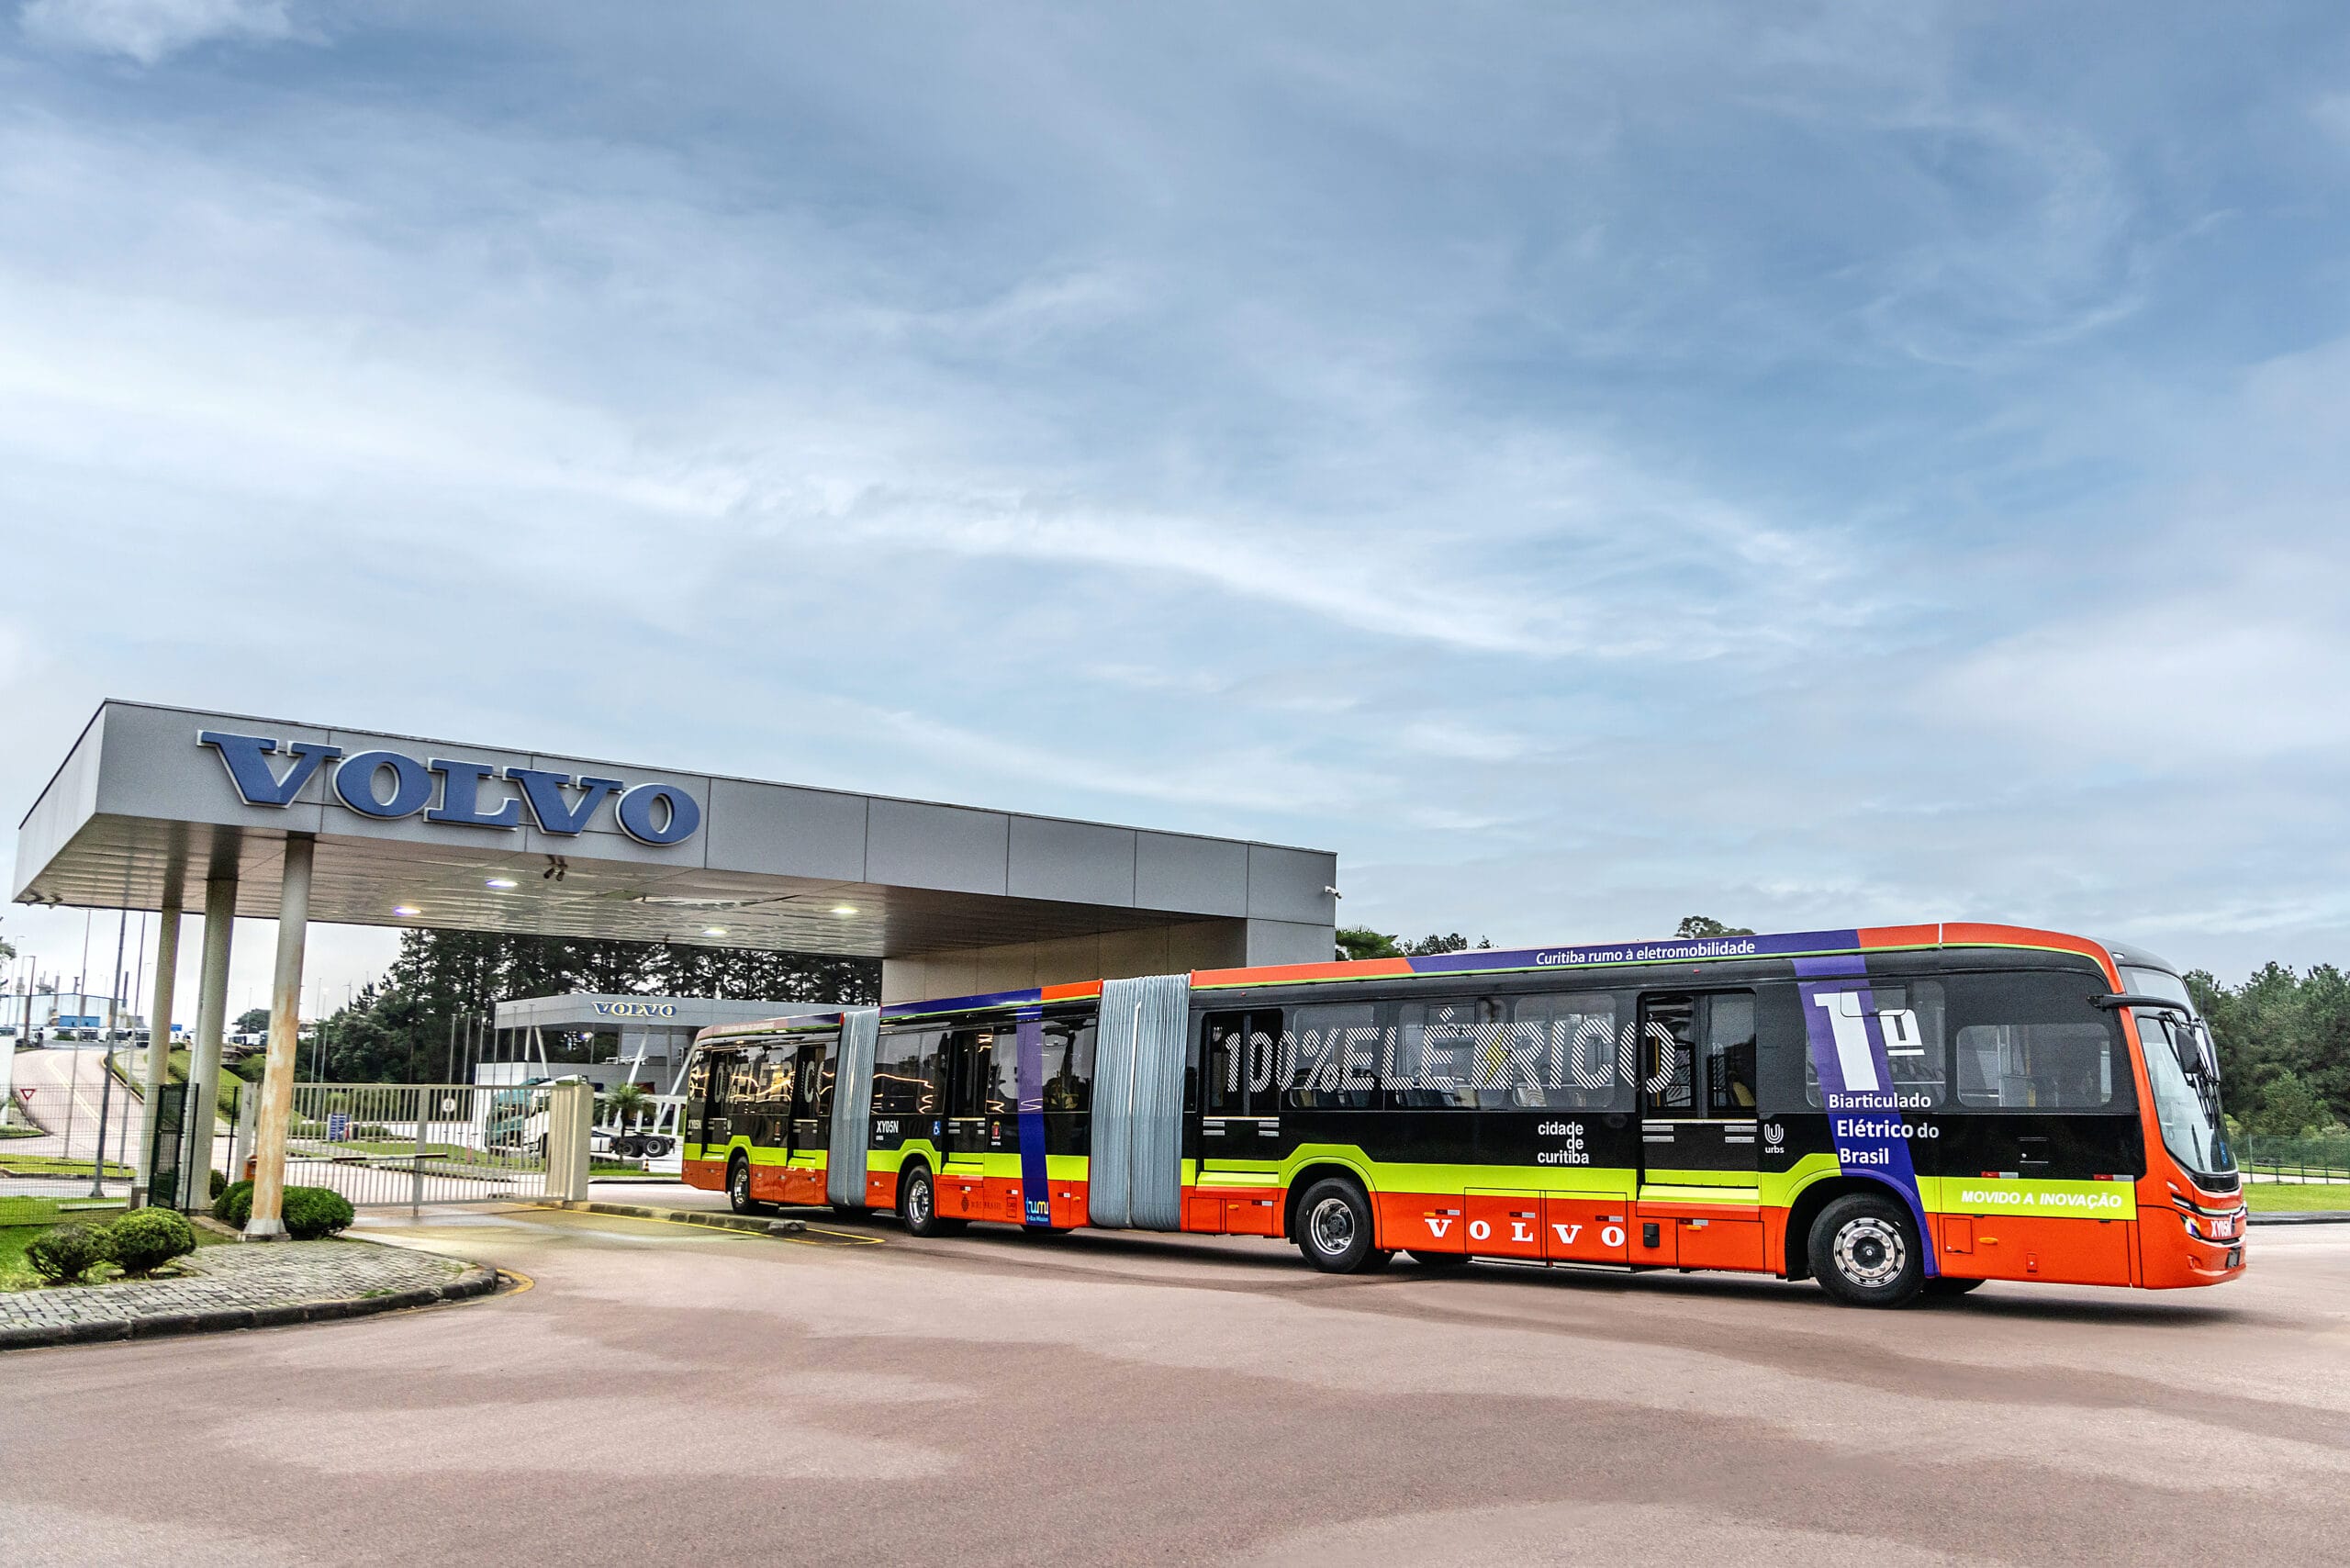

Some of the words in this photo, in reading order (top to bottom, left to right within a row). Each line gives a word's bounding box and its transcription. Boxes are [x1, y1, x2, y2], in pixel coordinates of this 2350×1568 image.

[197, 729, 700, 847] VOLVO
[1536, 950, 1585, 966] Curitiba
[1588, 949, 1623, 963] rumo
[1625, 947, 1633, 961] à
[1637, 940, 1756, 960] eletromobilidade
[591, 1001, 677, 1018] VOLVO
[1829, 1092, 1931, 1109] Biarticulado
[876, 1120, 899, 1134] XY05N
[1538, 1121, 1583, 1136] cidade
[1837, 1118, 1913, 1138] Elétrico
[1917, 1122, 1940, 1139] do
[1566, 1135, 1583, 1149] de
[1764, 1145, 1785, 1154] urbs
[1537, 1148, 1589, 1164] curitiba
[1840, 1148, 1890, 1165] Brasil
[1961, 1190, 2020, 1205] MOVIDO
[2023, 1193, 2034, 1205] A
[2040, 1193, 2122, 1209] INOVAÇÃO
[1424, 1217, 1626, 1248] VOLVO
